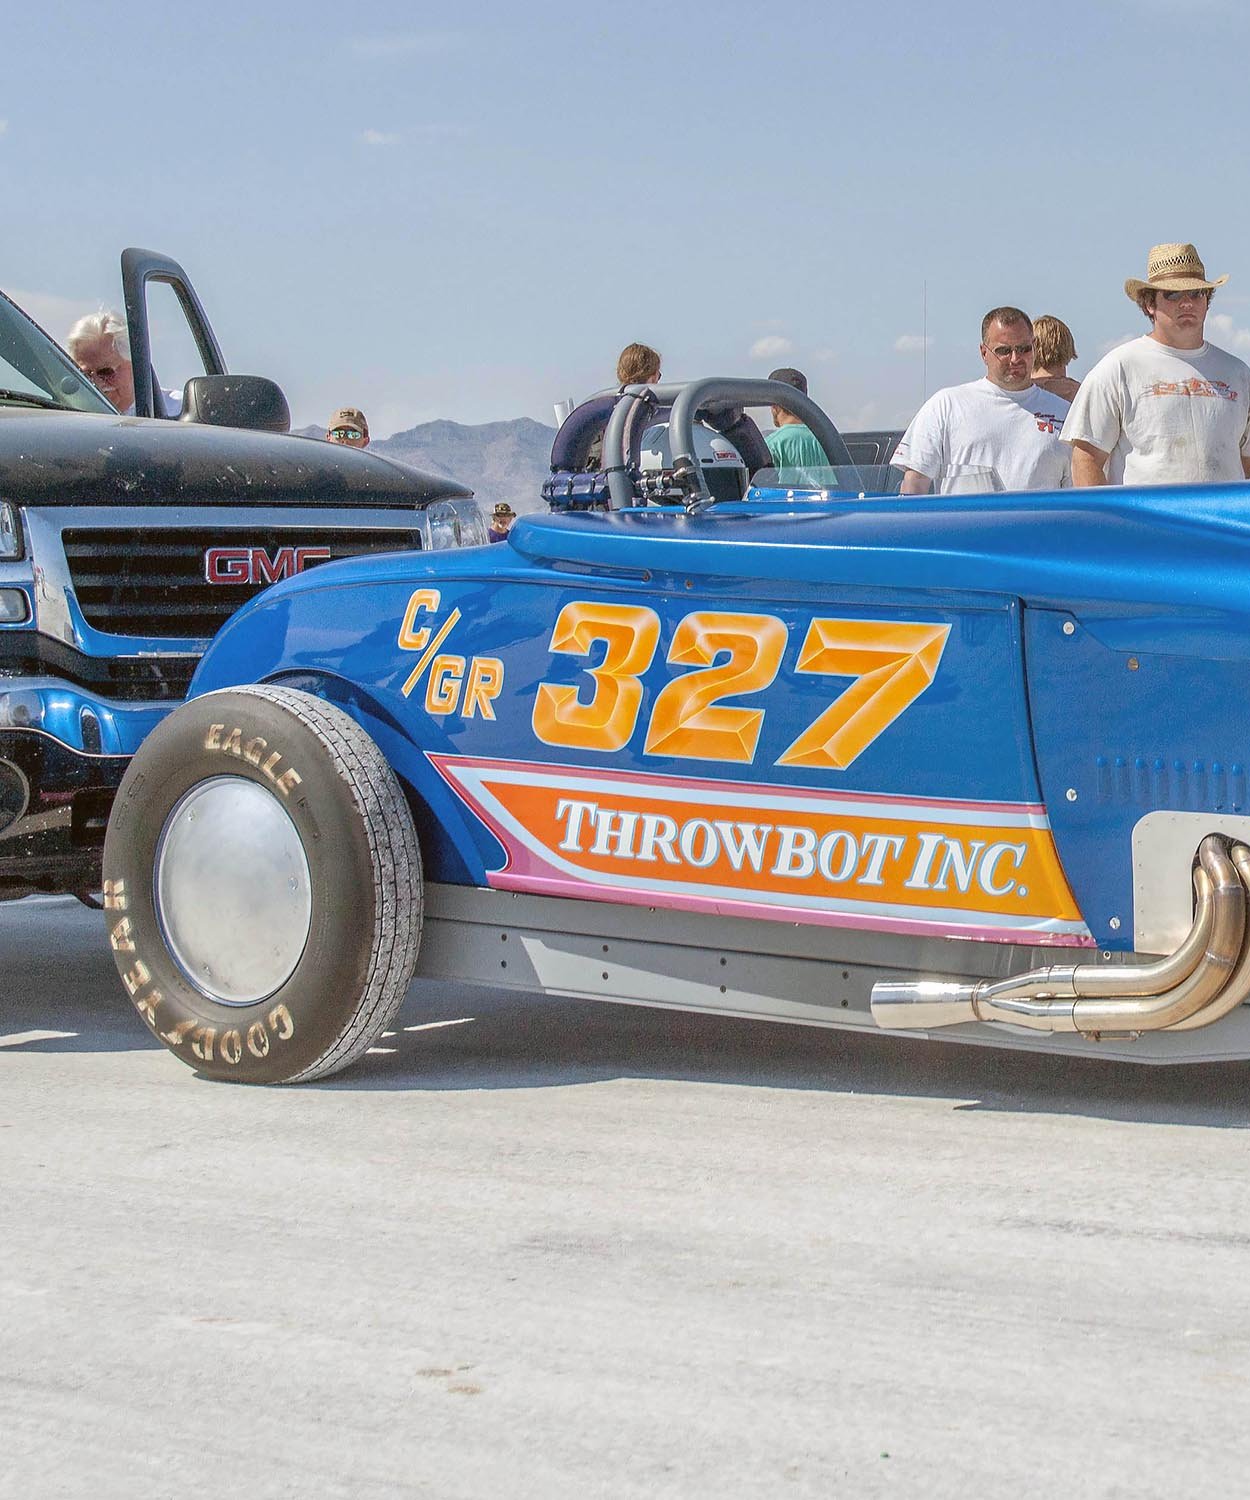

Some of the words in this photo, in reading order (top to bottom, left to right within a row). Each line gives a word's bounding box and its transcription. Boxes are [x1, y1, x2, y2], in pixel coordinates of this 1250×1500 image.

[532, 601, 952, 771] 327
[205, 724, 302, 795] EAGLE
[555, 799, 905, 885] THROWBOT
[904, 832, 1028, 896] INC.
[103, 879, 294, 1065] GOODYEAR
